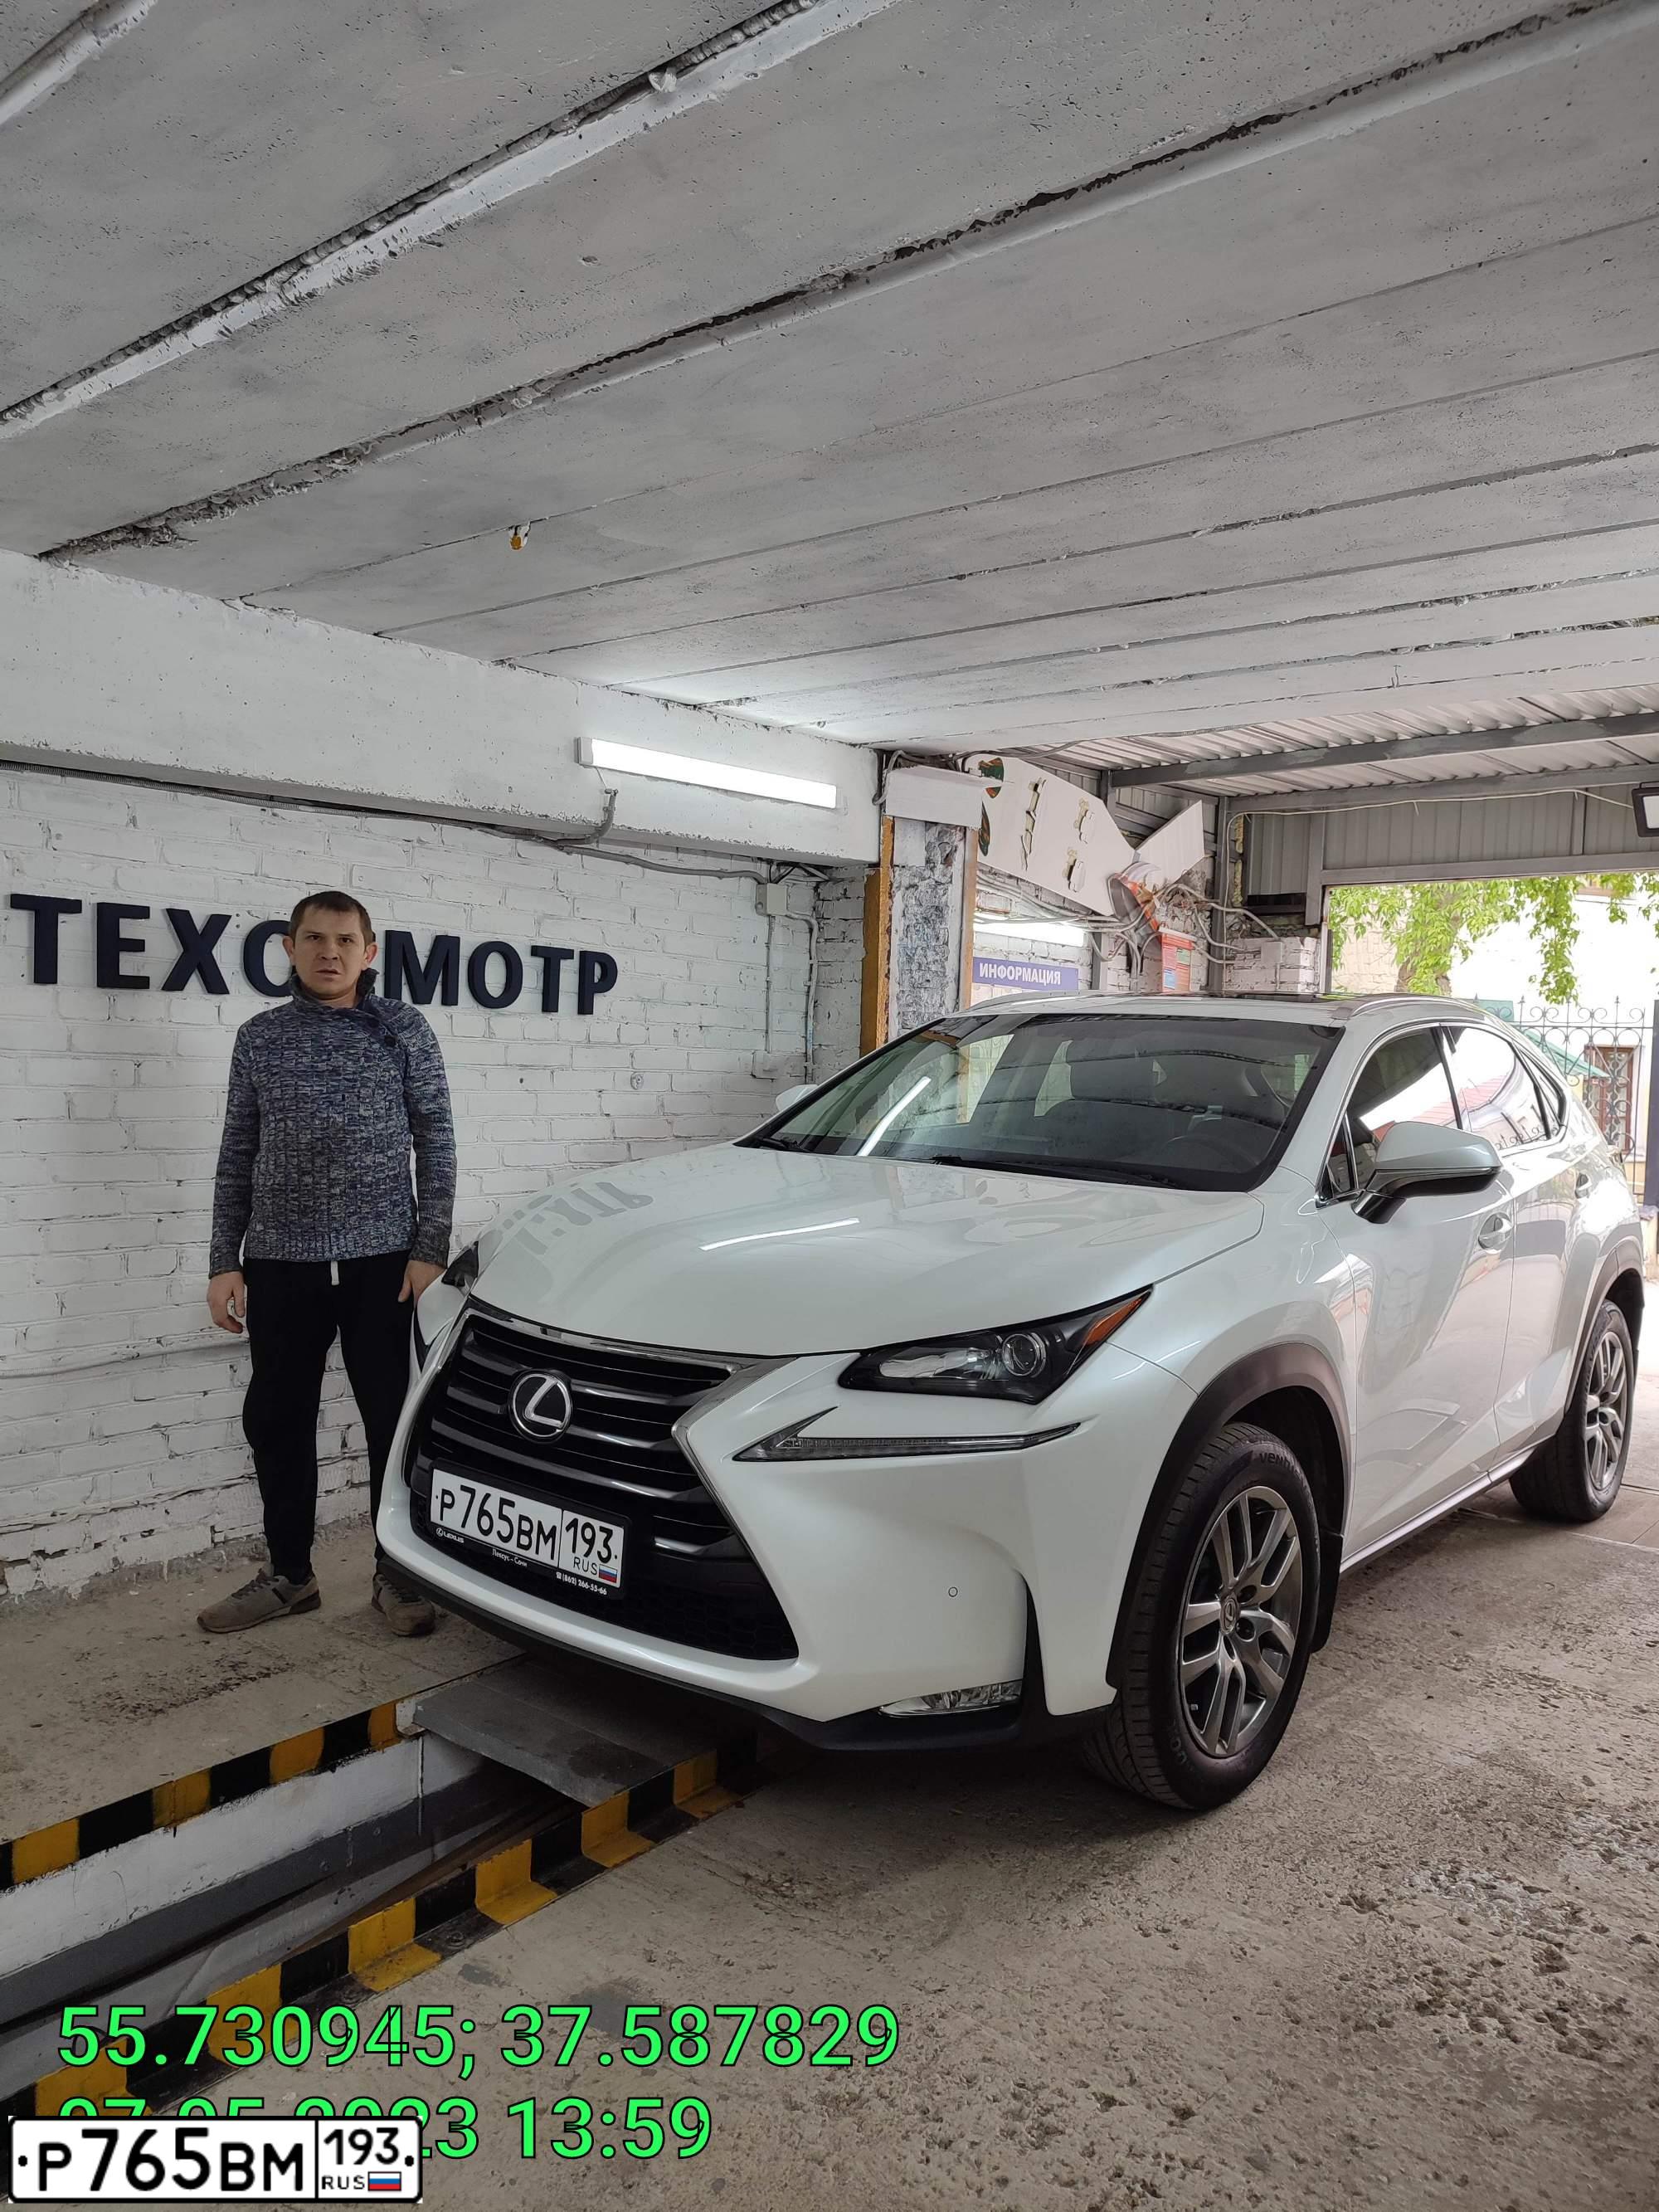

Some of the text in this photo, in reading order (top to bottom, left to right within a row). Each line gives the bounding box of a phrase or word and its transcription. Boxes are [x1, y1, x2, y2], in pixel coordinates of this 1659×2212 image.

[10, 893, 619, 1015] ТЕХОМОТР
[979, 962, 1061, 986] ИНФОРМАЦИЯ
[443, 1530, 465, 1543] LEXUS
[565, 1518, 613, 1564] 193
[573, 1557, 597, 1576] RUS
